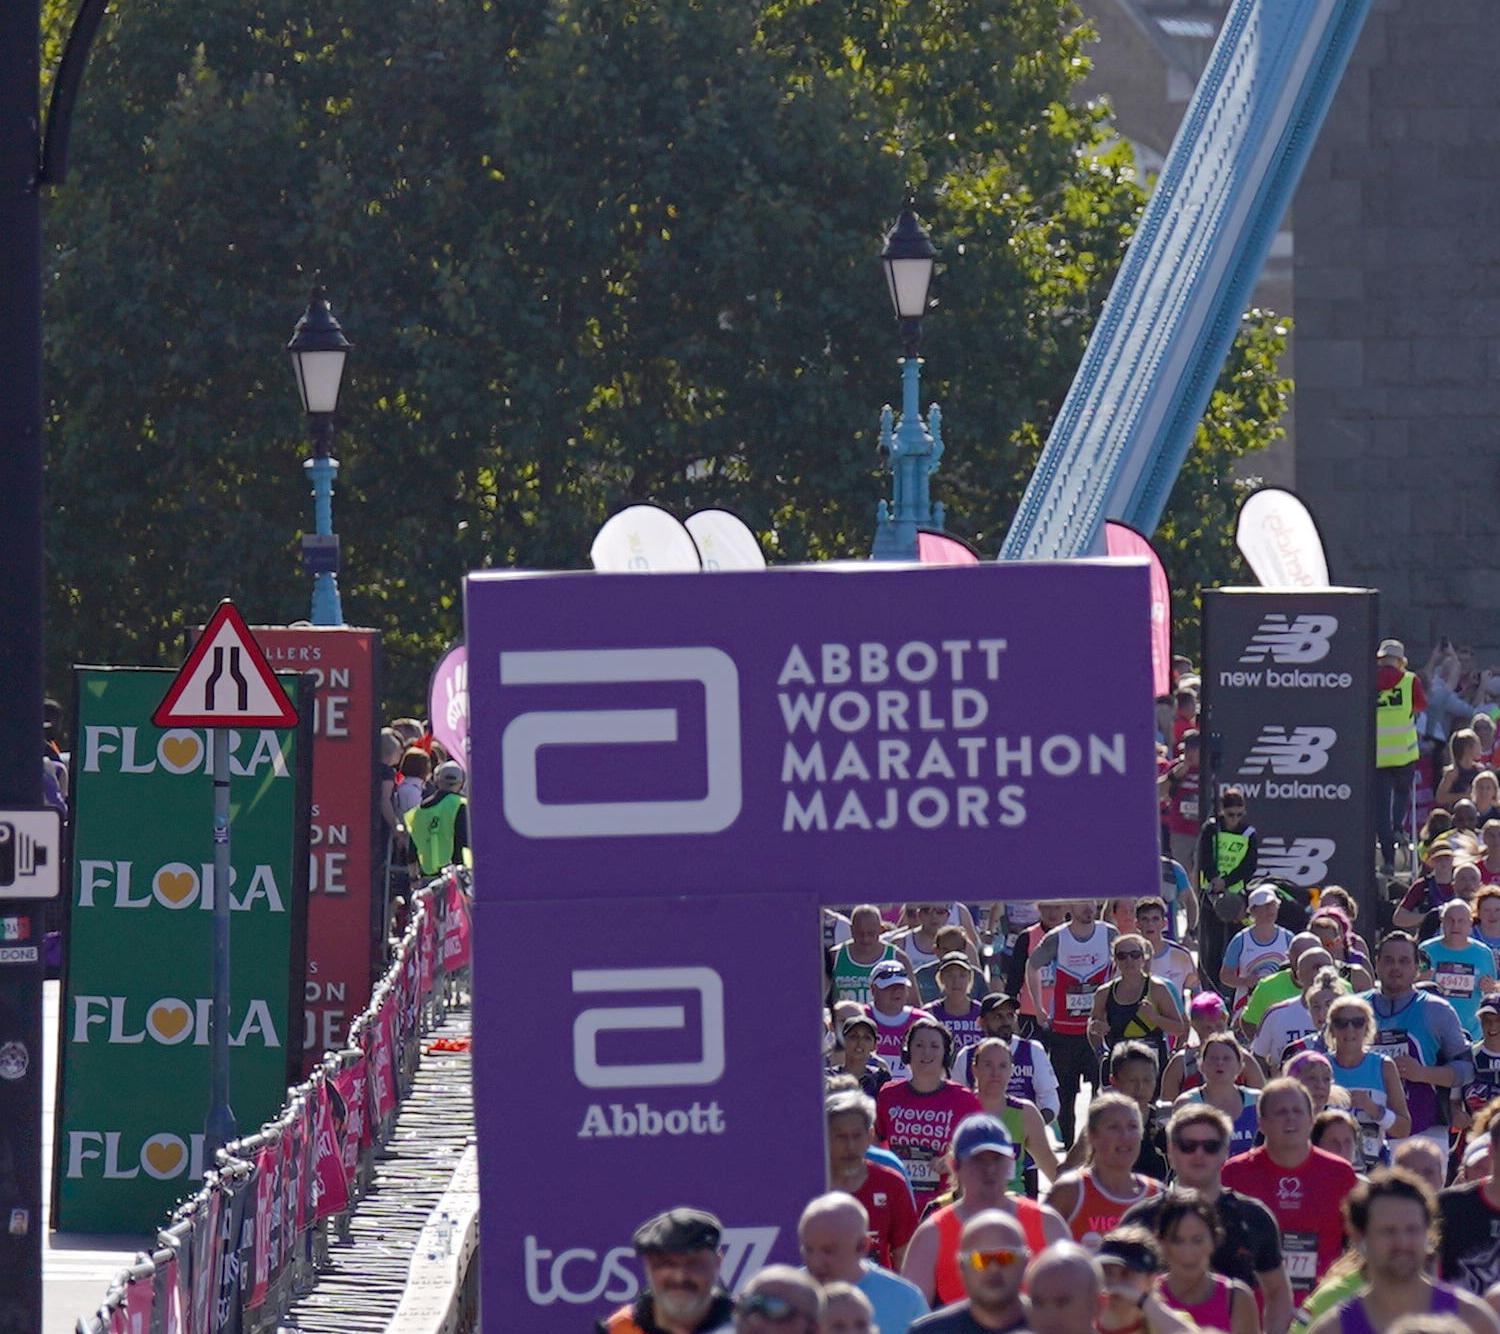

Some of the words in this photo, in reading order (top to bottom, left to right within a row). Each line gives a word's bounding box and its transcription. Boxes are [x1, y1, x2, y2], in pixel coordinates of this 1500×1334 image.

[263, 646, 322, 661] LLER'S
[778, 639, 1007, 685] ABBOTT
[1220, 671, 1262, 687] new
[1266, 668, 1352, 688] balance
[778, 688, 989, 734] WORLD
[83, 725, 291, 778] FLORA
[780, 734, 1126, 783] MARATHON
[781, 785, 1028, 833] MAJORS
[1265, 780, 1352, 800] balance
[78, 859, 286, 912] FLORA
[577, 1101, 726, 1138] Abbott
[888, 1105, 953, 1122] prevent
[895, 1121, 951, 1138] breast
[66, 1131, 206, 1181] FLO
[525, 1234, 640, 1307] tcs
